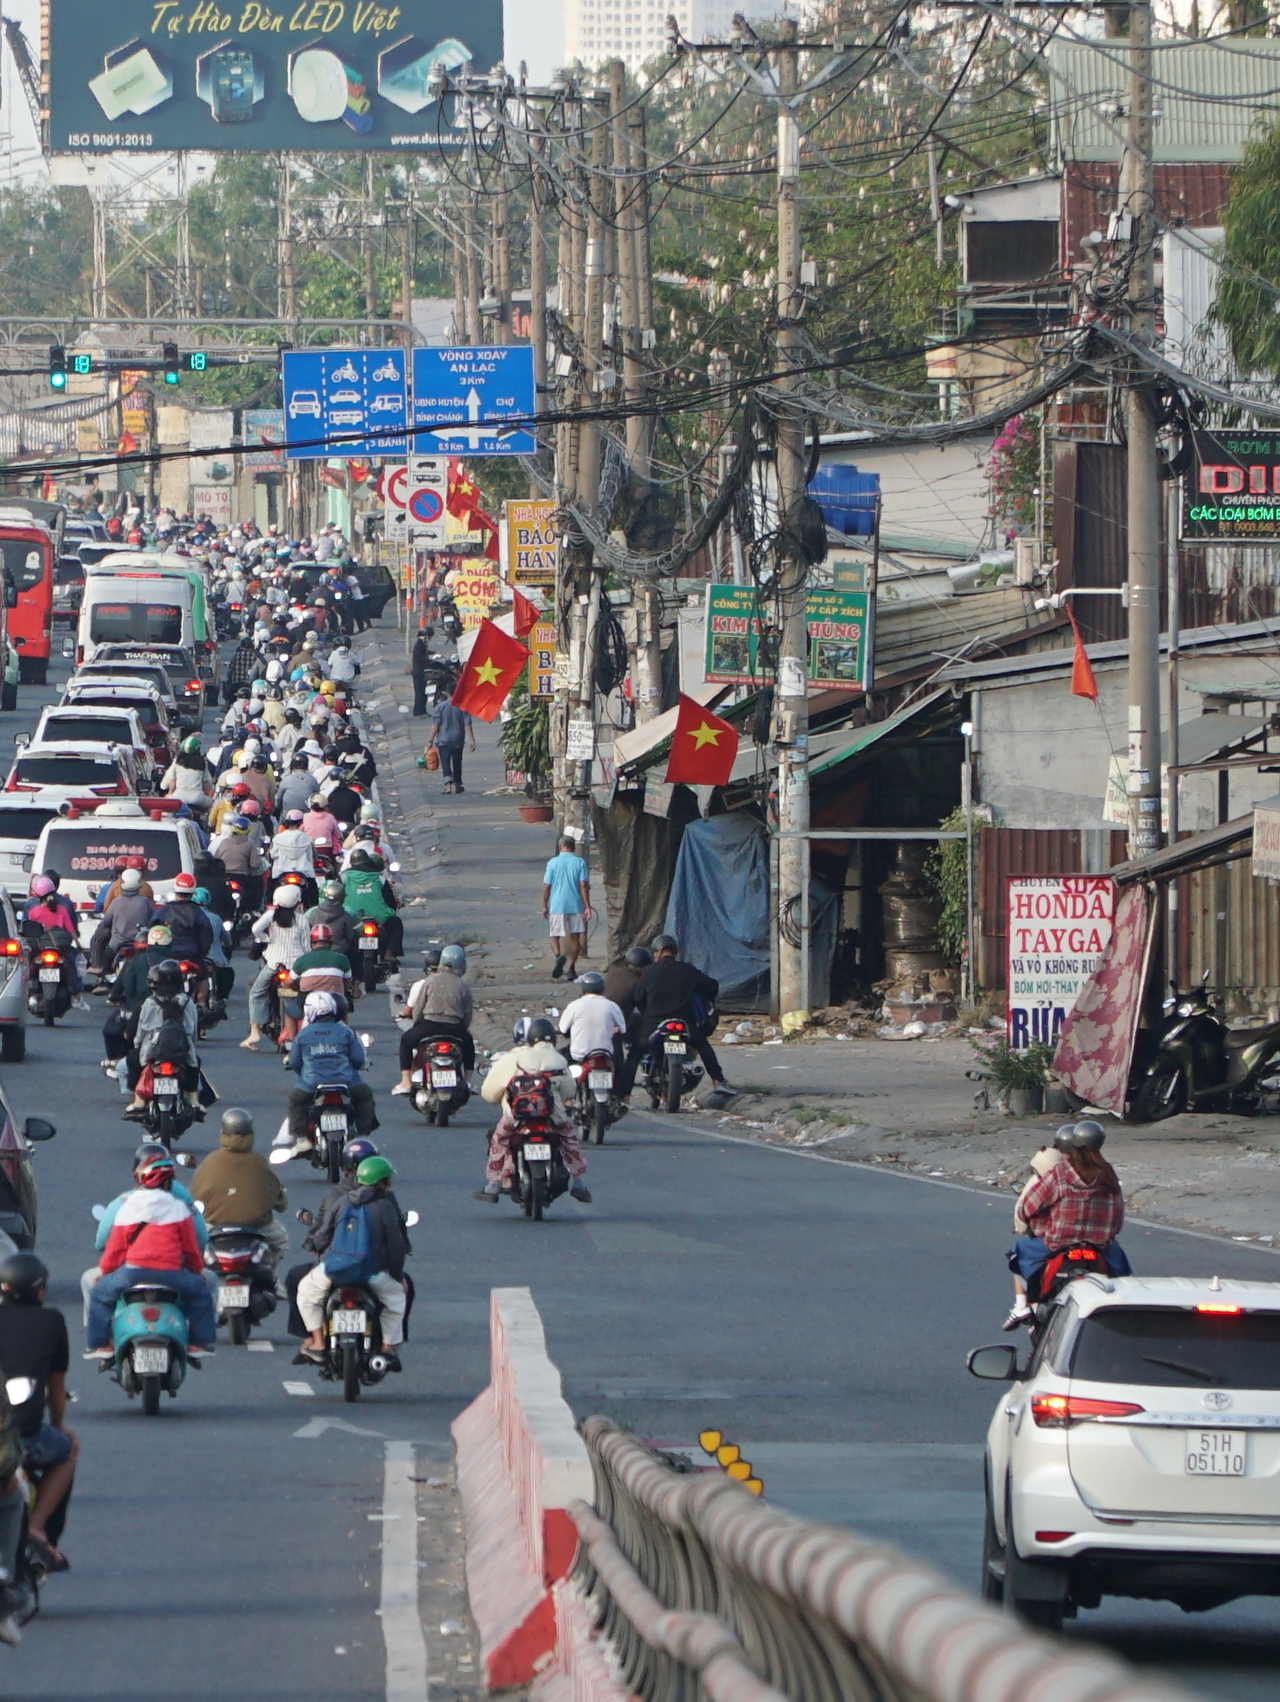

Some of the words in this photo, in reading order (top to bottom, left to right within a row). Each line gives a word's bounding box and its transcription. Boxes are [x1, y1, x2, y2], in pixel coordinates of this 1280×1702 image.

[151, 3, 181, 38] Tự
[187, 3, 230, 33] Hào
[238, 0, 281, 33] Đèn
[289, 3, 345, 33] LED
[352, 2, 401, 38] Việt
[68, 133, 90, 147] ISO
[439, 349, 473, 361] VÒNG
[476, 351, 508, 361] XOAY
[450, 363, 468, 373] AN
[472, 363, 496, 375] LẠC
[378, 436, 406, 448] BÁNH
[1190, 505, 1218, 521] CÁC
[1220, 508, 1246, 523] LOẠI
[1247, 506, 1274, 521] BƠM
[517, 521, 556, 546] BẢO
[713, 598, 739, 610] CÔNG
[711, 616, 748, 634] KIM
[1014, 893, 1107, 920] HONDA
[1015, 928, 1104, 954] TAYGA
[1045, 955, 1079, 975] KHÔNG
[1200, 1433, 1232, 1453] 51H
[1187, 1453, 1243, 1473] 051.10
